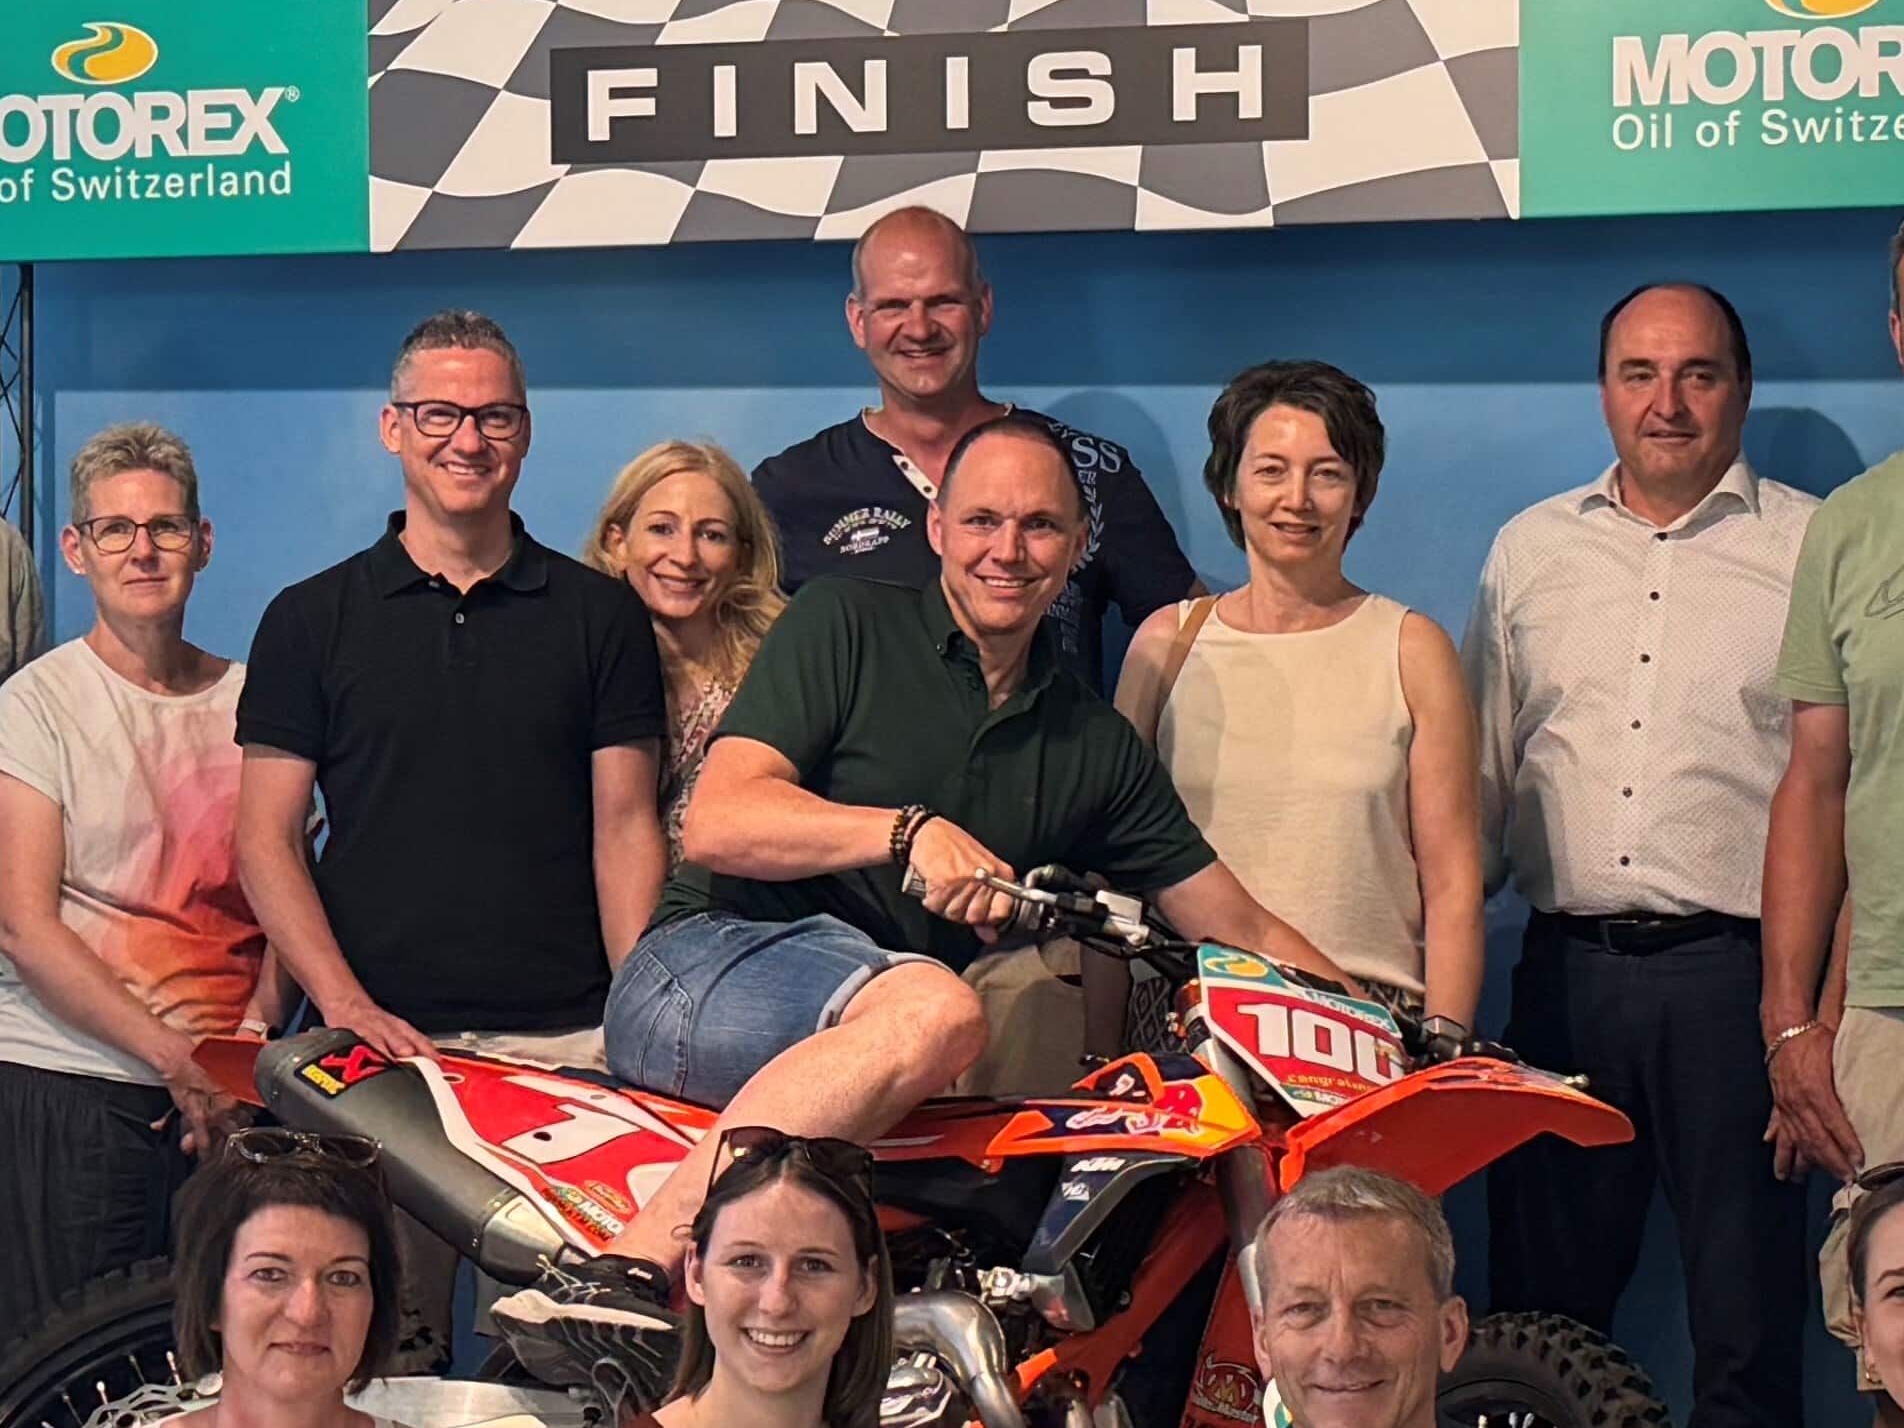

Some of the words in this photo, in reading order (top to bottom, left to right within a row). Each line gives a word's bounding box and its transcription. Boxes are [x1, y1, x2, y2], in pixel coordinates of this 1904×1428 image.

[586, 44, 1264, 143] FINISH
[1612, 112, 1672, 150] Oil
[1697, 108, 1739, 147] of
[52, 161, 292, 203] Switzerland
[1070, 436, 1121, 473] SS
[1077, 469, 1097, 485] ER
[873, 506, 912, 528] RALLY
[1237, 1003, 1405, 1087] 100
[577, 1200, 626, 1236] MOTO
